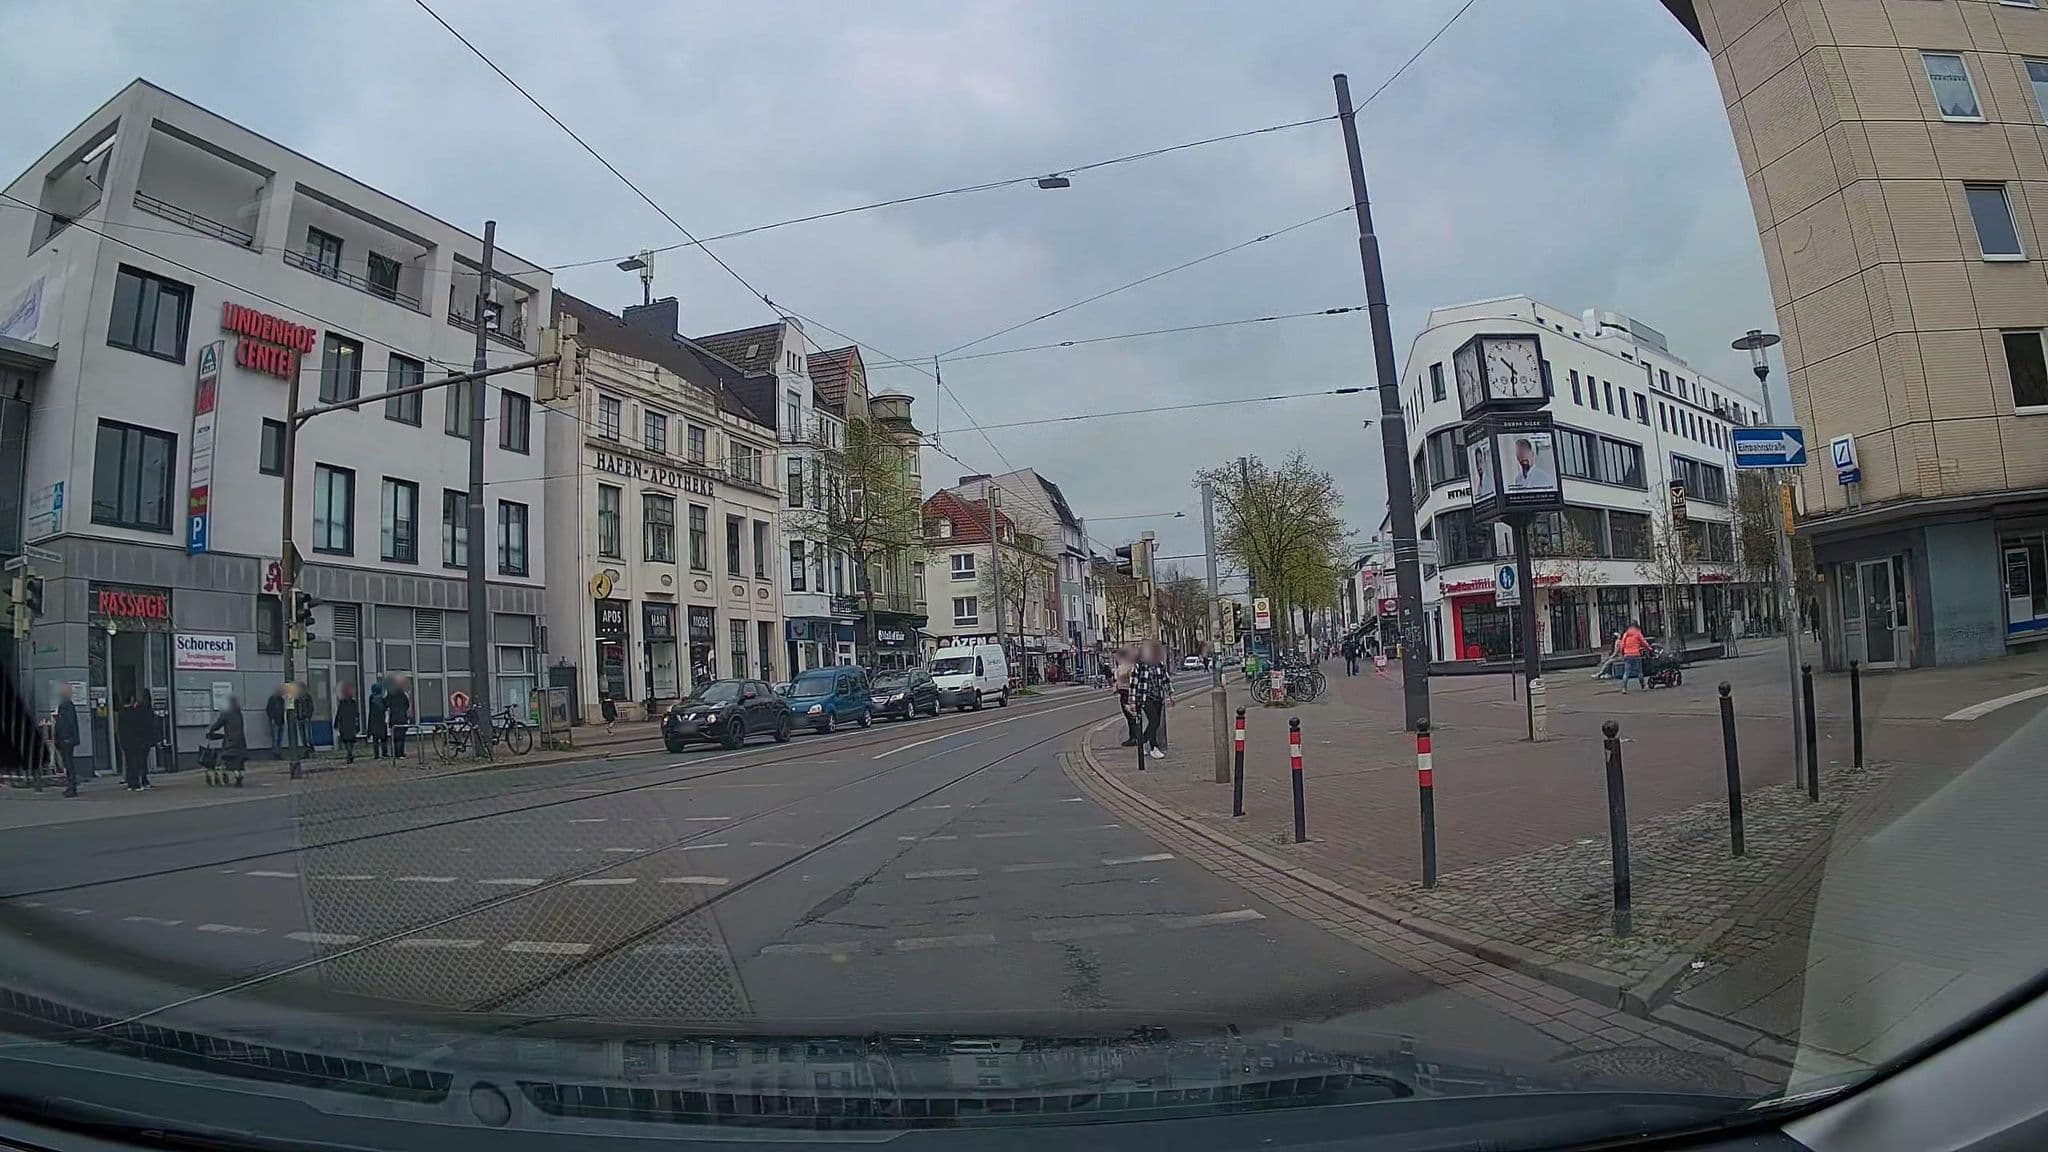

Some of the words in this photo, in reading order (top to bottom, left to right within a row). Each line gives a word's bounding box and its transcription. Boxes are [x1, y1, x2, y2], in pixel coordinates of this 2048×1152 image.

[222, 301, 316, 353] LINDENHOF
[1447, 487, 1472, 499] FITNE
[193, 517, 202, 540] P
[98, 590, 166, 619] PASSAGE
[602, 609, 622, 623] APOS
[651, 614, 667, 627] HAIR
[177, 635, 234, 652] Schoresch
